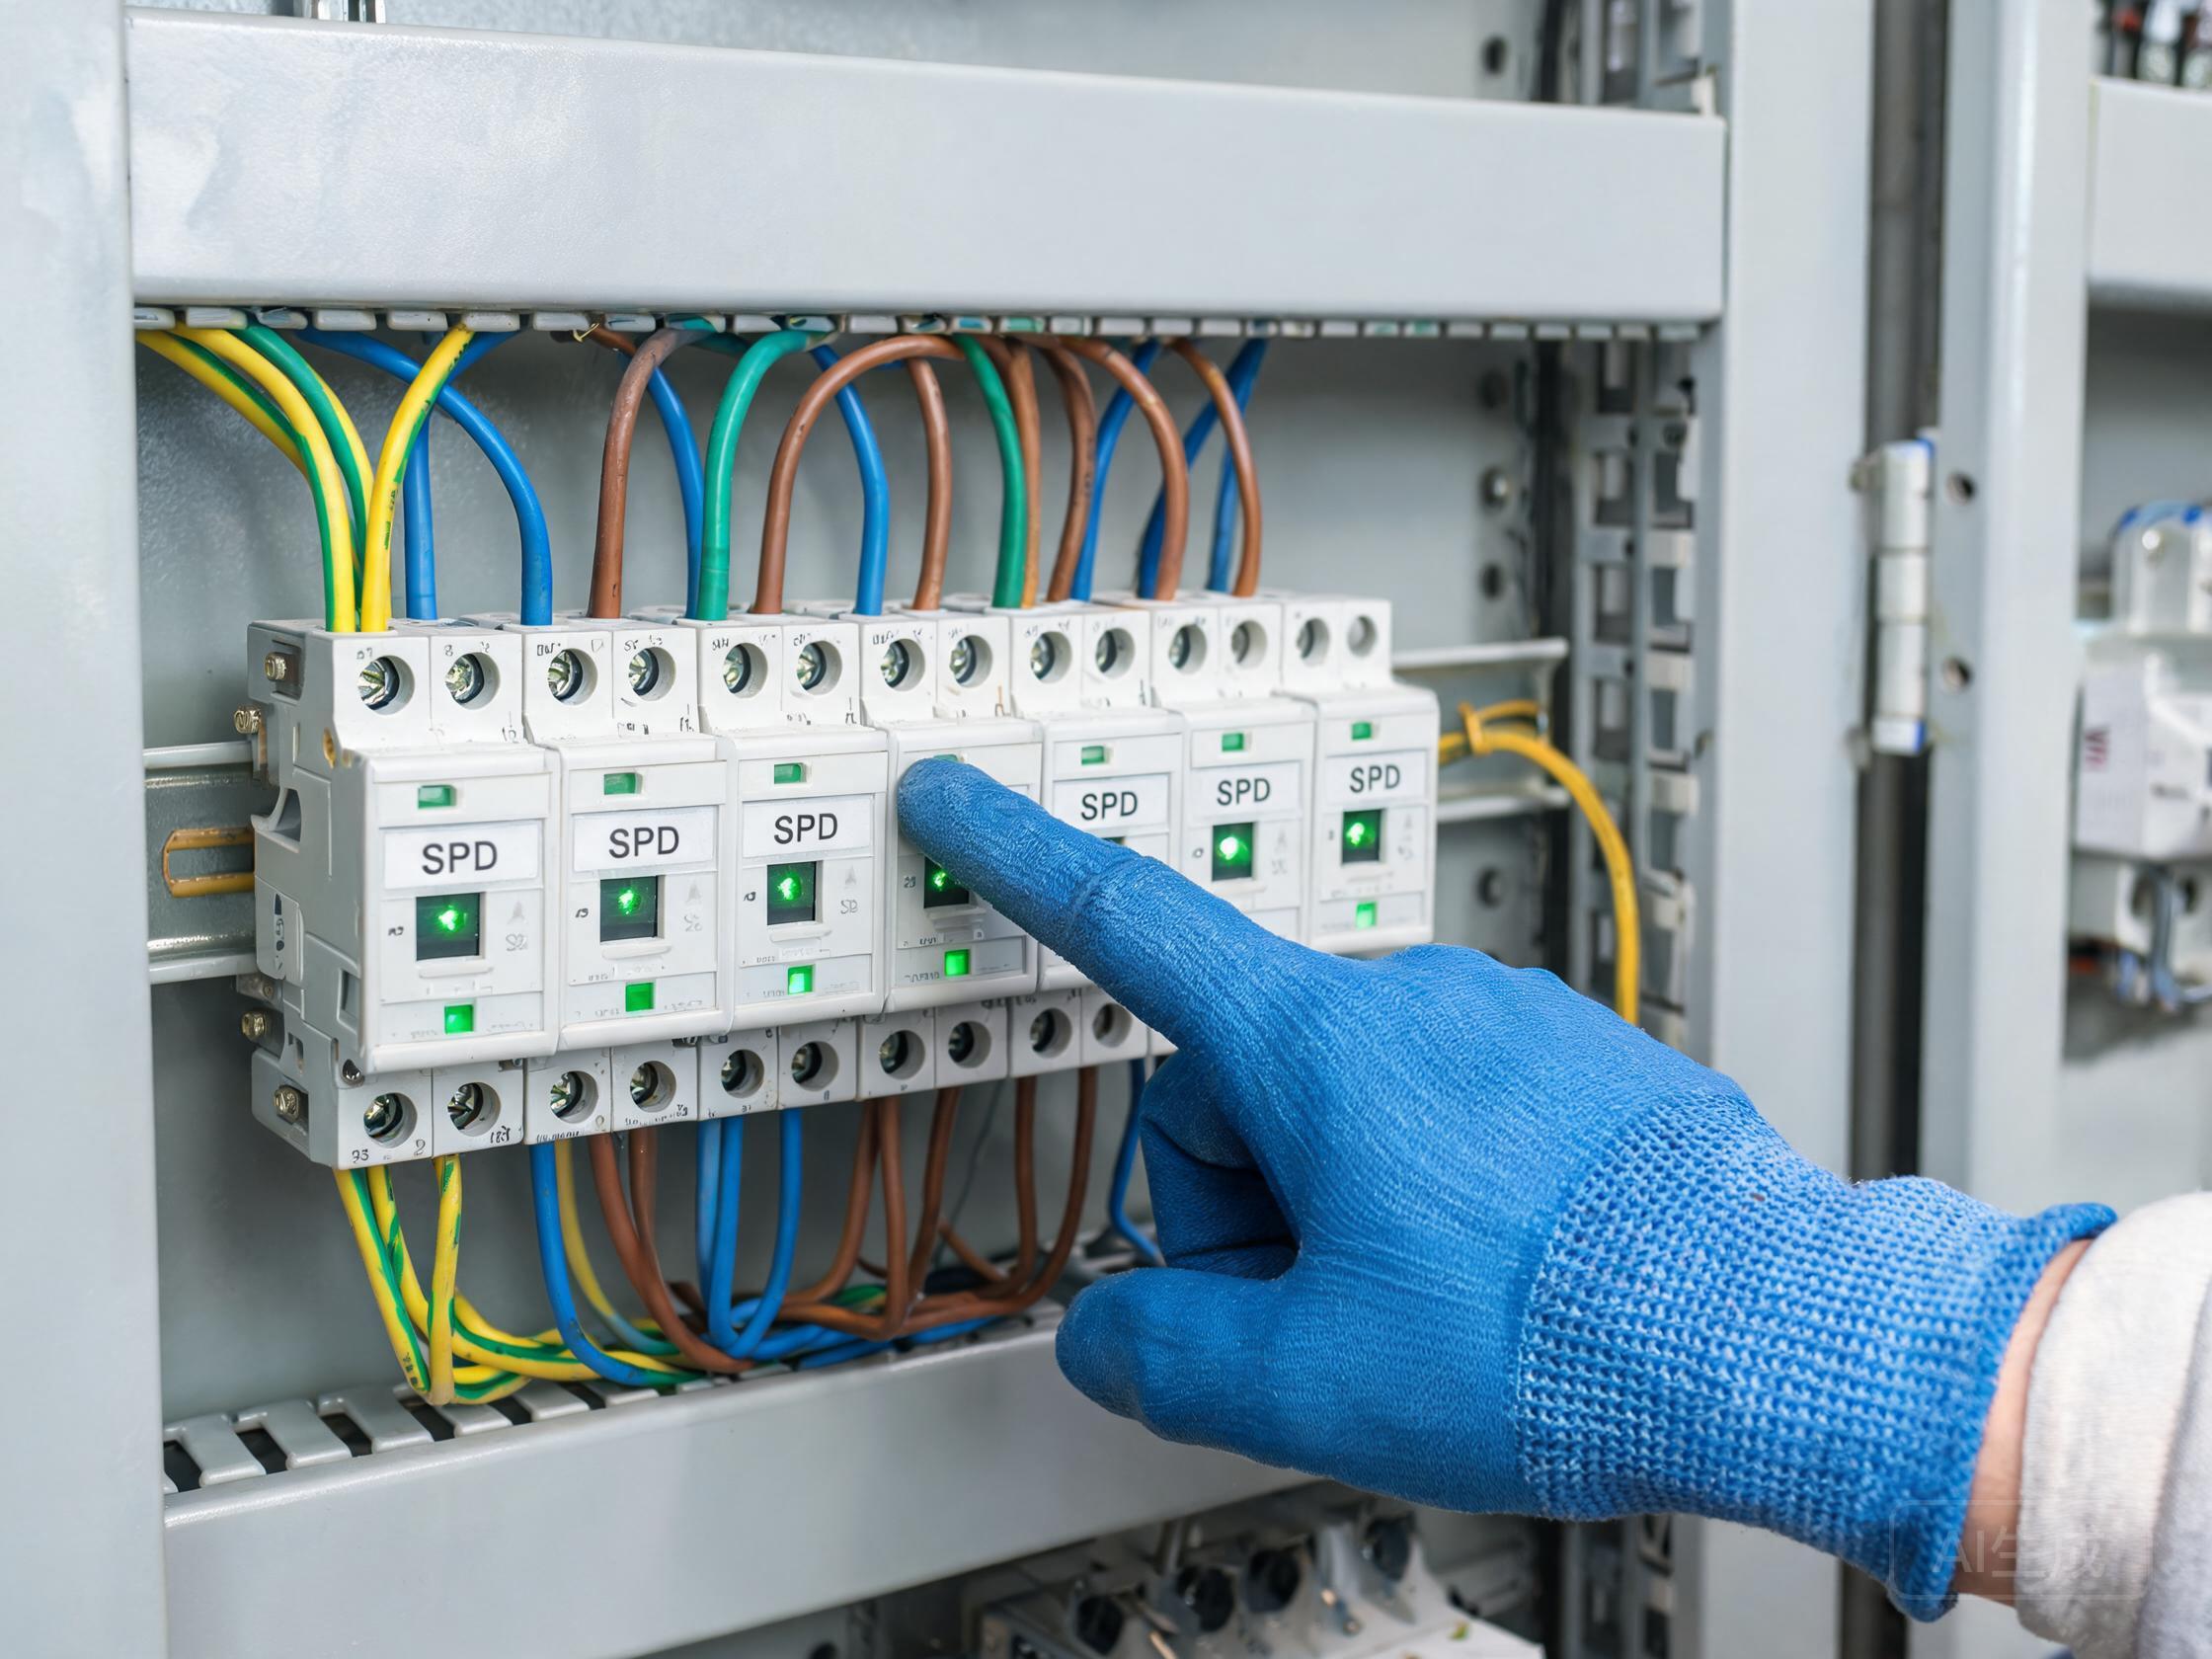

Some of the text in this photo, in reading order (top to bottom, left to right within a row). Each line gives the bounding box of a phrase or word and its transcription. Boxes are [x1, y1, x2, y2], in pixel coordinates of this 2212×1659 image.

[1217, 778, 1271, 806] SPD
[1350, 764, 1400, 793] SPD
[1080, 791, 1138, 821] SPD
[608, 826, 679, 859] SPD
[773, 813, 838, 845] SPD
[422, 840, 498, 875] SPD
